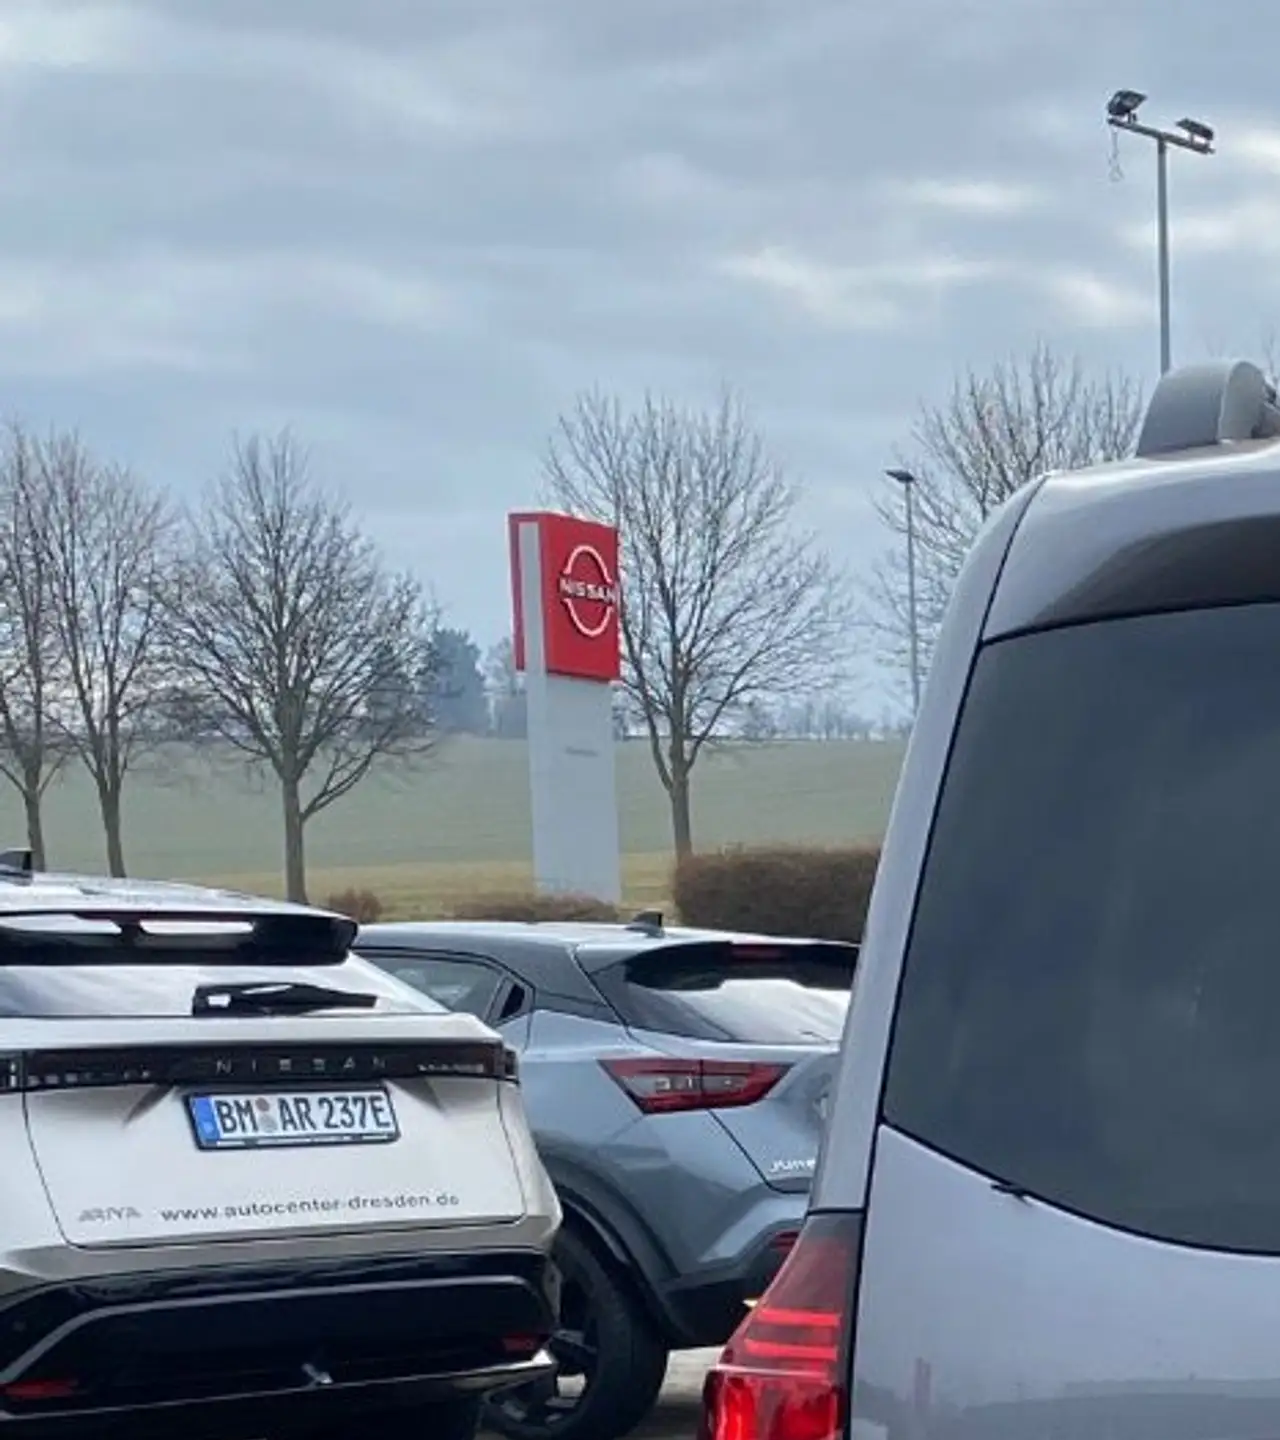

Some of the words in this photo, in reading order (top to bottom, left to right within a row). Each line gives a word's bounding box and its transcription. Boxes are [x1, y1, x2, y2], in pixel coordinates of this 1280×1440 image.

[559, 577, 617, 605] NISSAN
[215, 1056, 386, 1075] NISSAN
[215, 1097, 260, 1135] BM
[276, 1096, 318, 1132] AR
[318, 1094, 391, 1131] 237E
